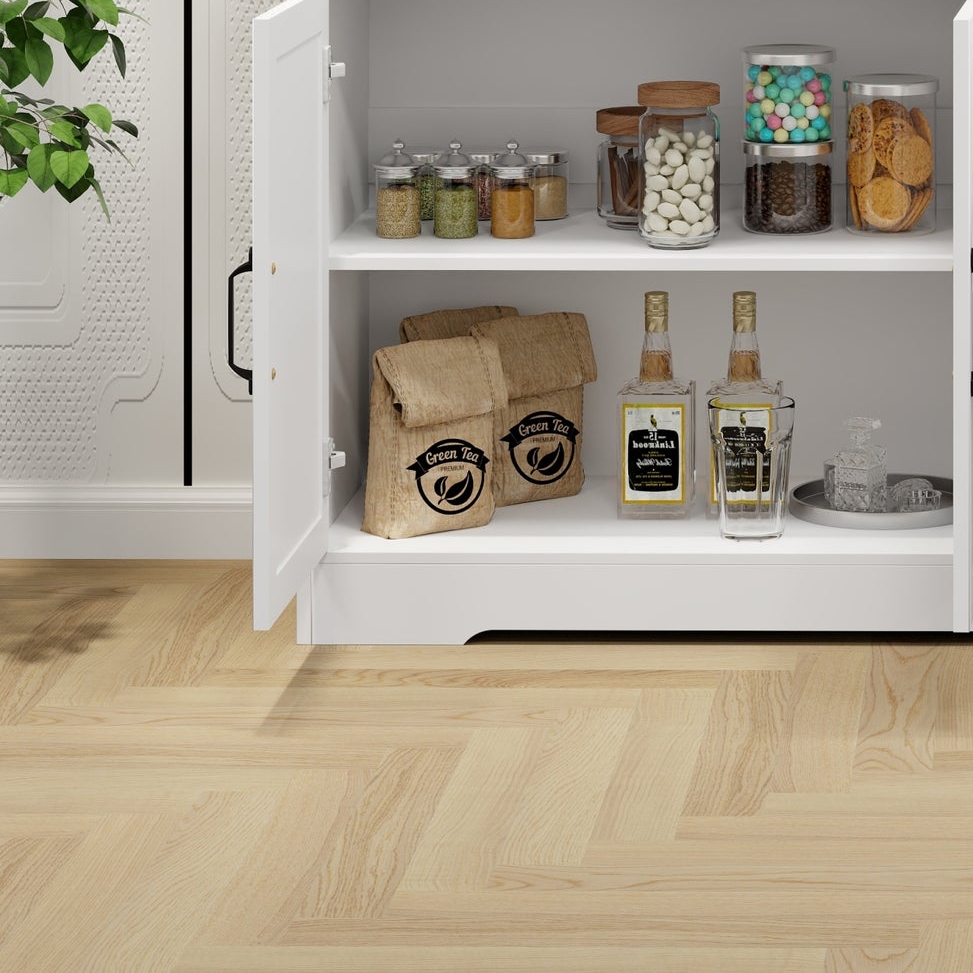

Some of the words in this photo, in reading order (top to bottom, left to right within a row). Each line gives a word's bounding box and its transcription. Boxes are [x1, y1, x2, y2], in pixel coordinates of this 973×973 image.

[518, 421, 549, 437] Green
[552, 419, 570, 434] Tea
[425, 449, 458, 465] Green
[461, 447, 480, 462] Tea
